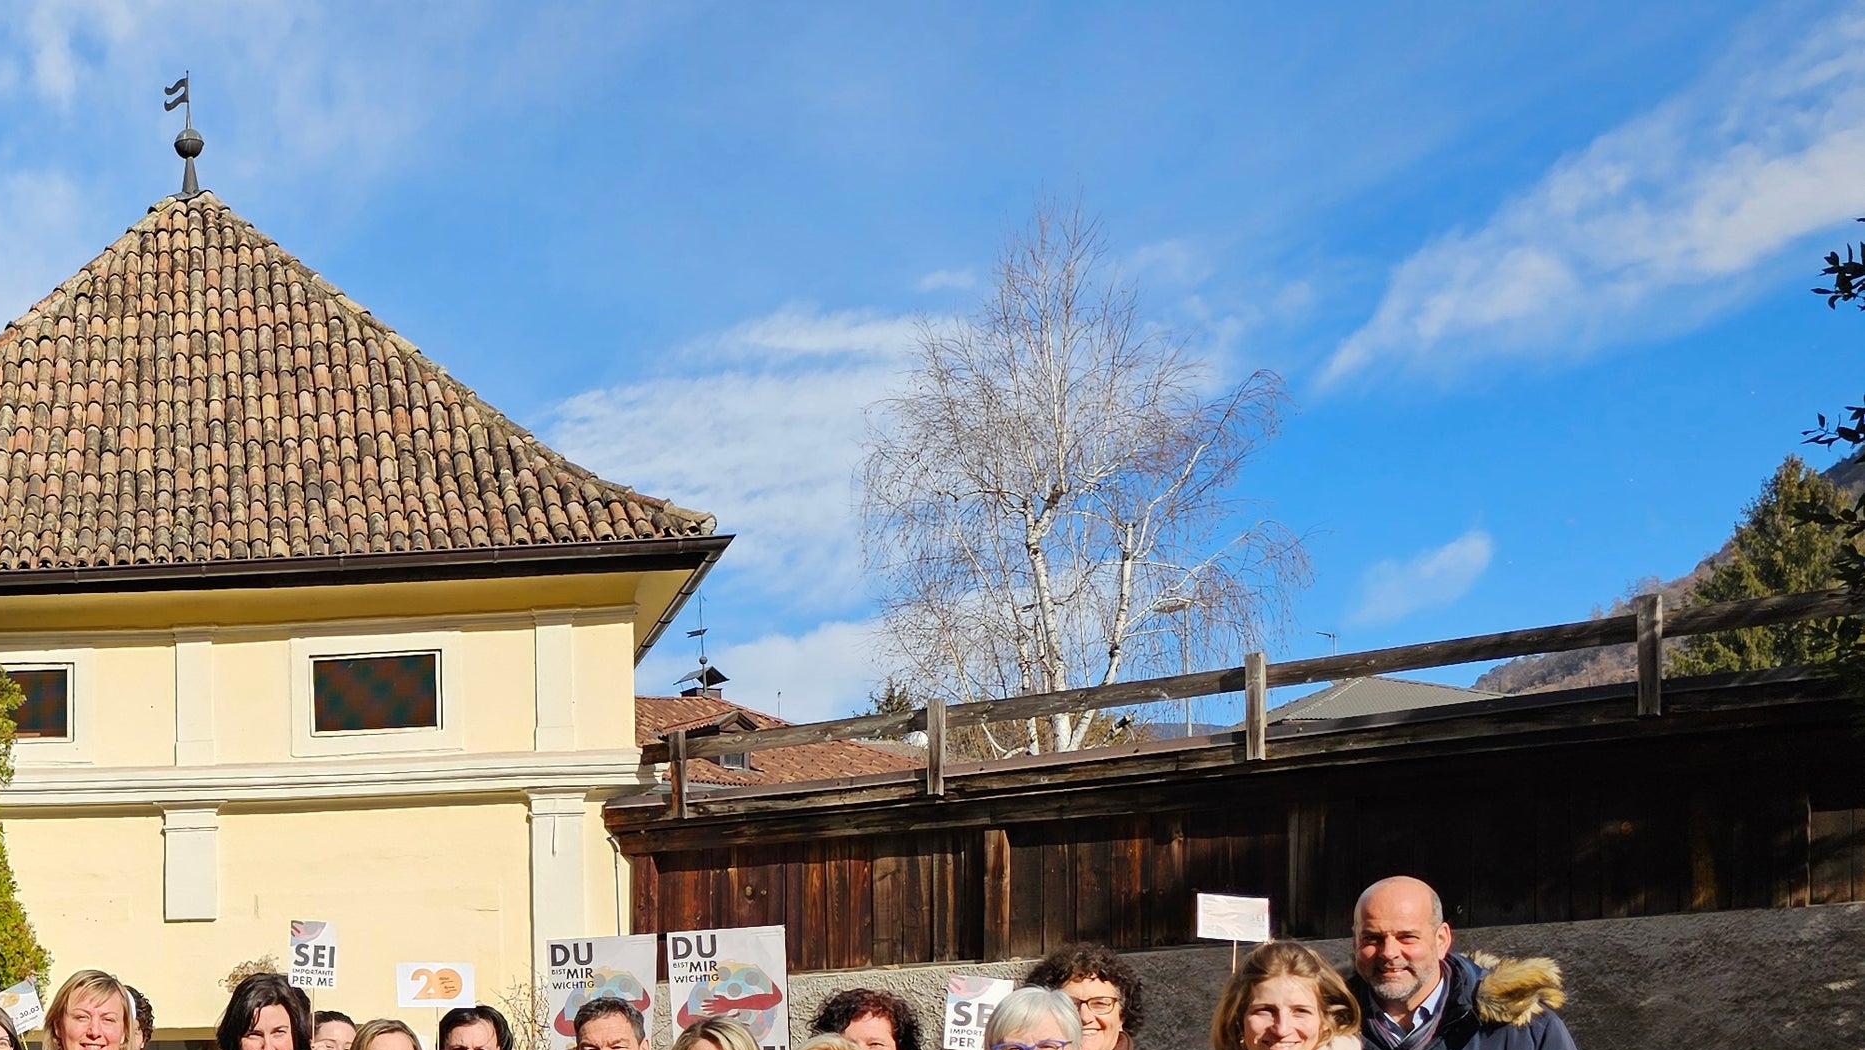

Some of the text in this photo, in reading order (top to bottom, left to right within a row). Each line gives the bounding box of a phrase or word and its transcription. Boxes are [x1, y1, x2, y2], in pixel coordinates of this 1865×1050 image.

[672, 934, 717, 959] DU
[293, 943, 335, 968] SEI
[551, 942, 593, 966] DU
[292, 968, 334, 976] IMPORTANTE
[689, 961, 718, 972] MIR
[566, 968, 594, 979] MIR
[674, 974, 720, 983] WICHTIG
[292, 976, 334, 986] PER ME
[411, 968, 463, 1000] 20
[552, 981, 595, 990] WICHTIG
[19, 1005, 40, 1019] 30.03
[951, 1001, 995, 1028] SE
[949, 1037, 976, 1048] PER
